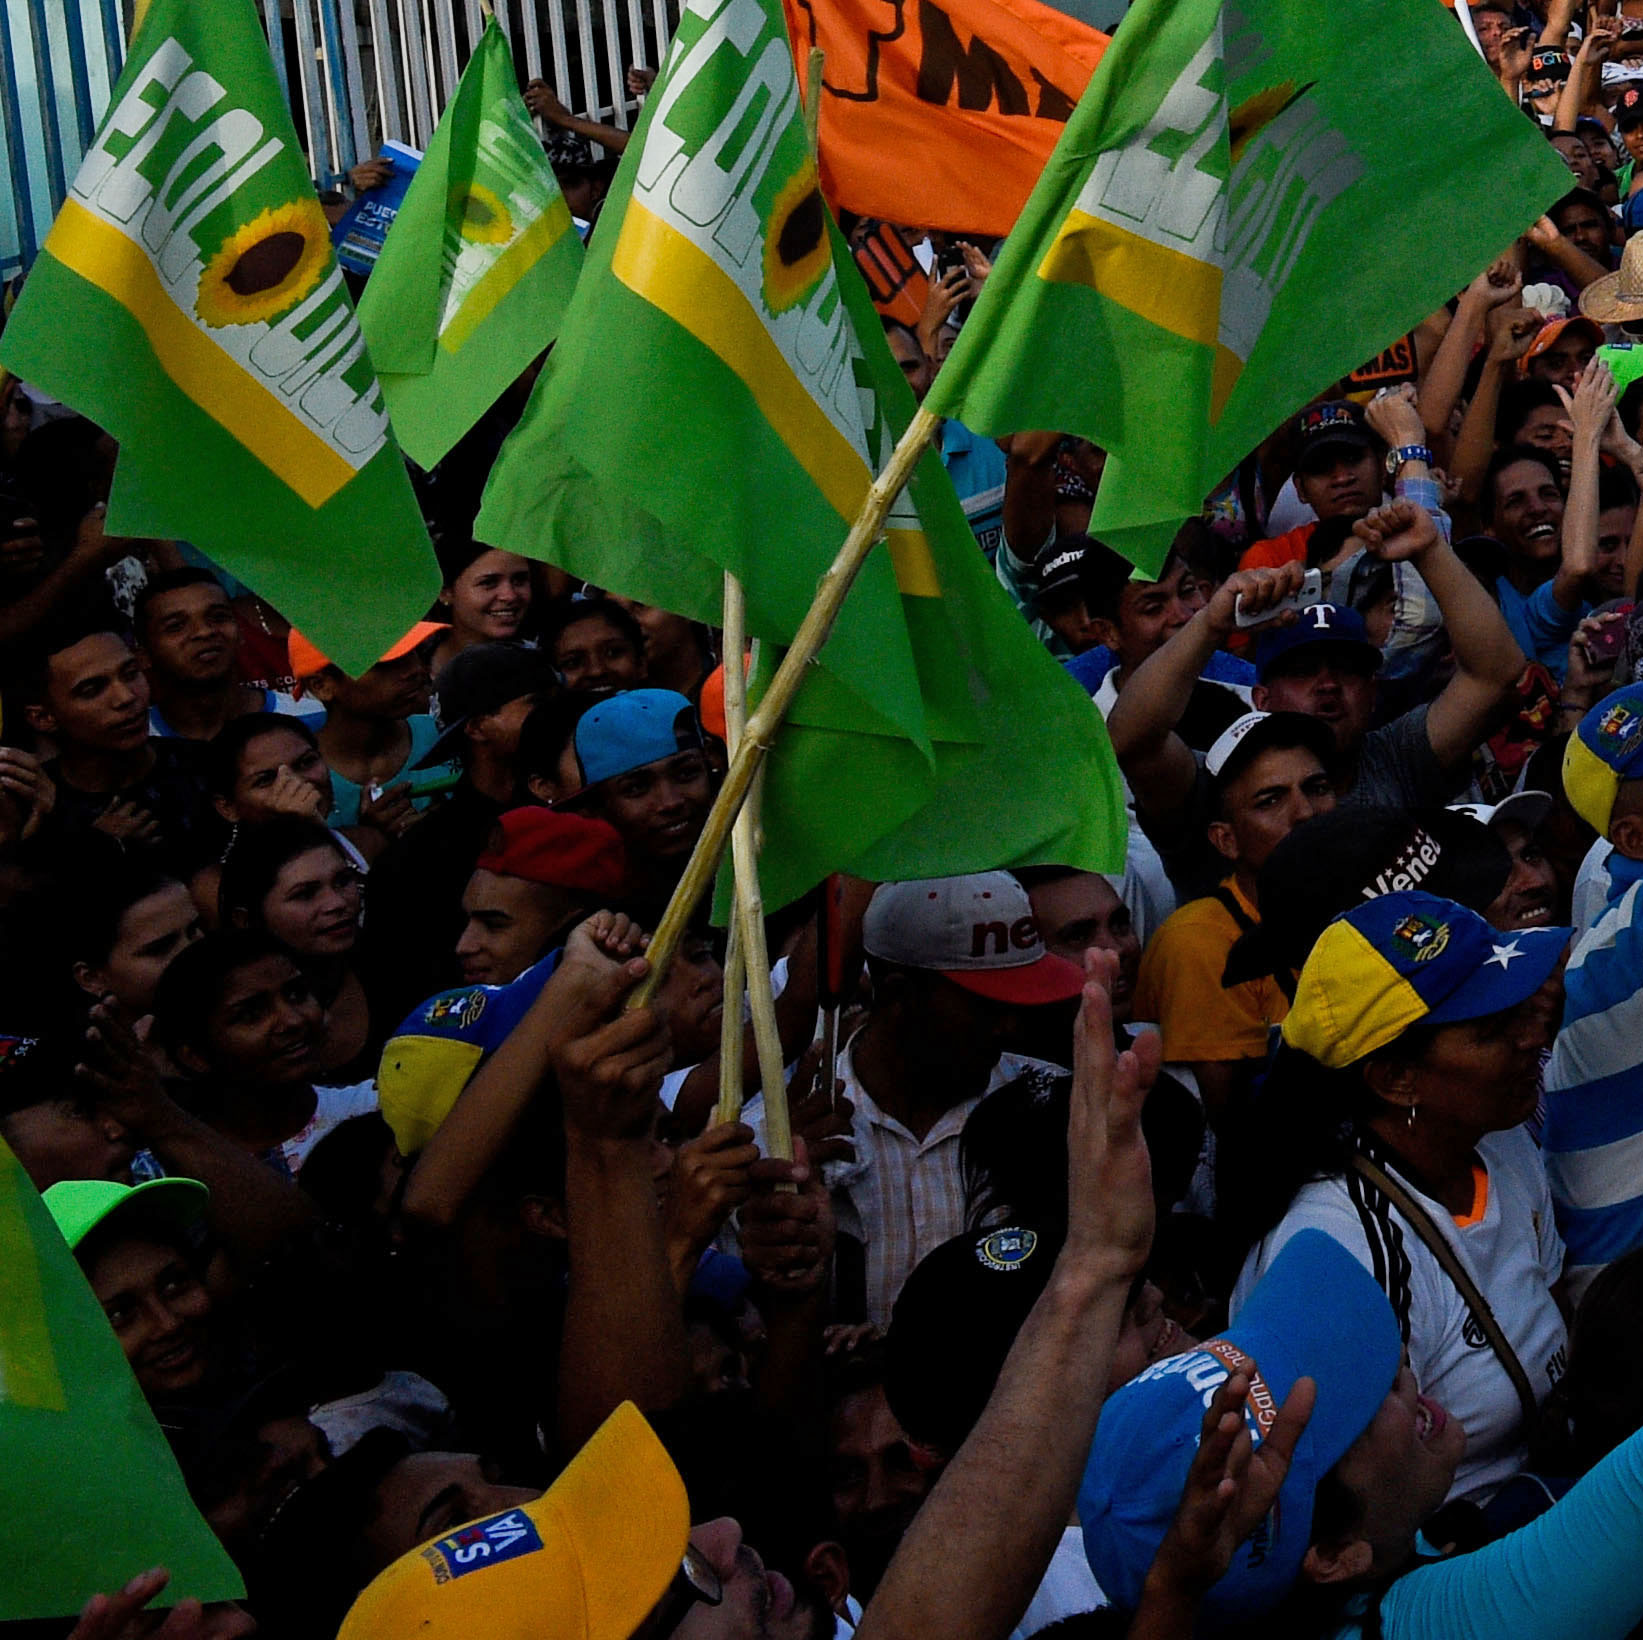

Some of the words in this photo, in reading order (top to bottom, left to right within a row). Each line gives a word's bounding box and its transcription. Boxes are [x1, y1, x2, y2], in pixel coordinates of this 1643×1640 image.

[1303, 603, 1337, 628] T
[970, 915, 1041, 957] ne
[484, 1513, 528, 1553] VA
